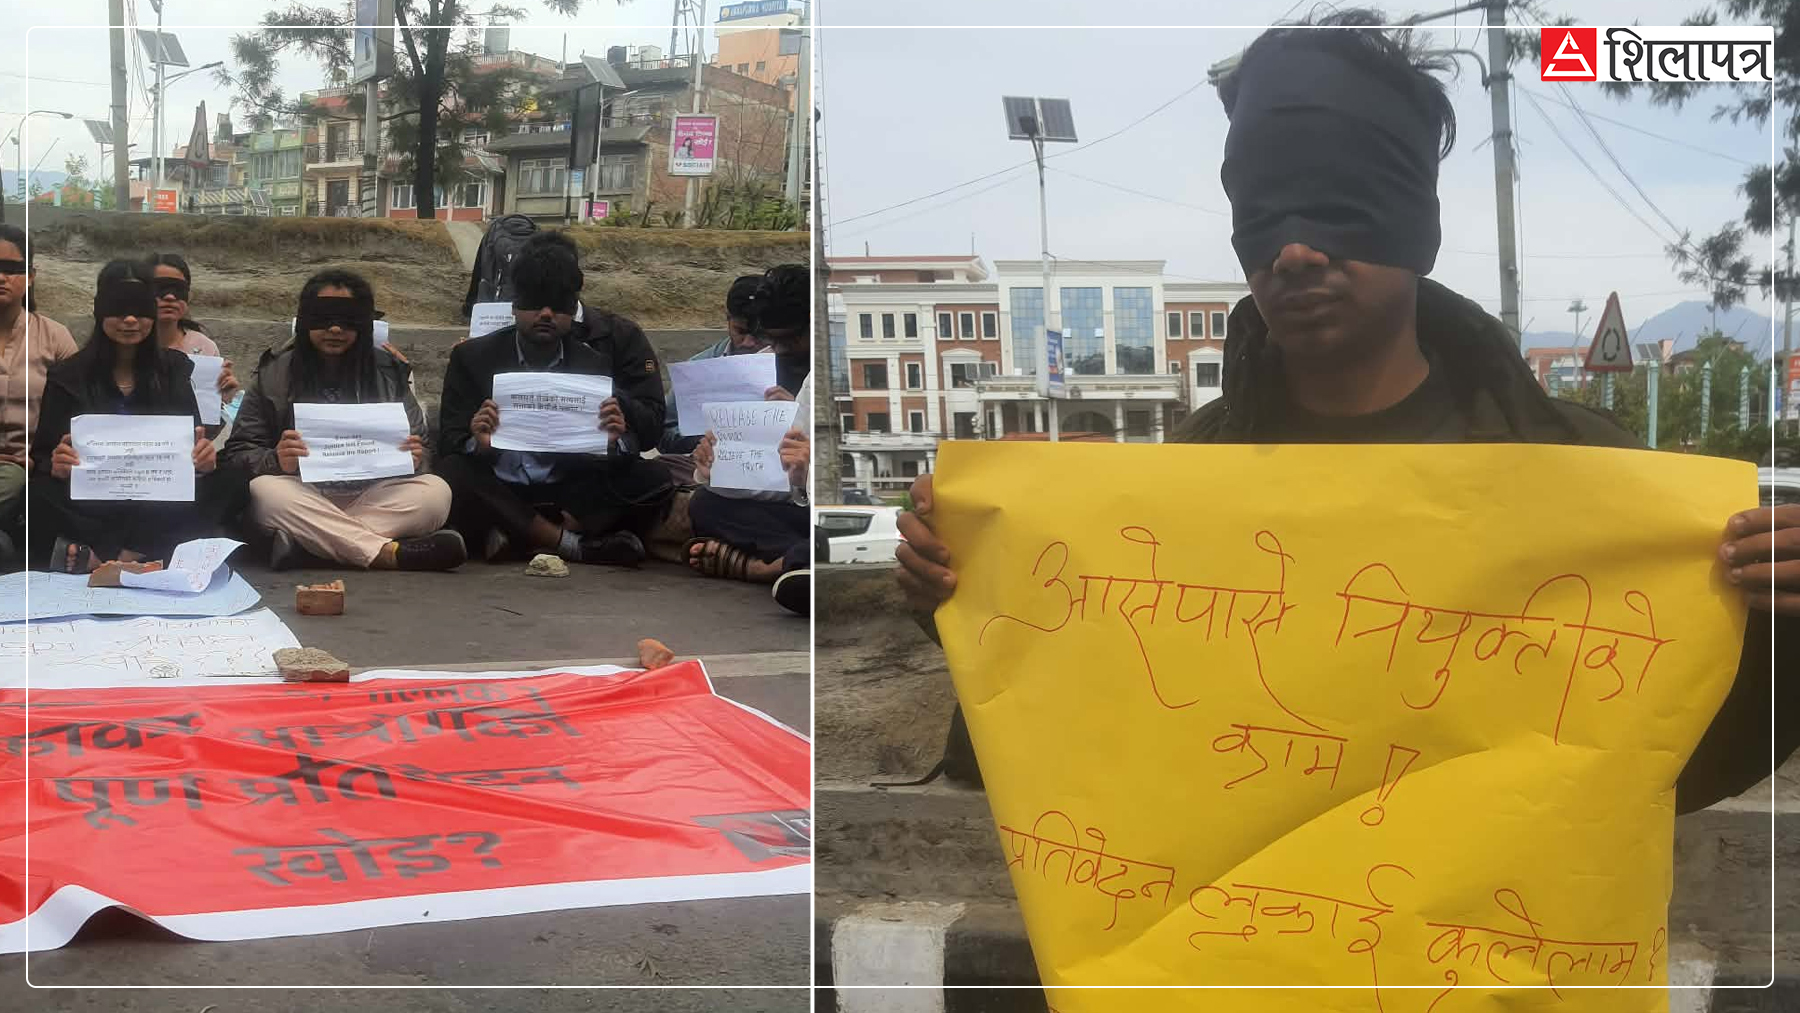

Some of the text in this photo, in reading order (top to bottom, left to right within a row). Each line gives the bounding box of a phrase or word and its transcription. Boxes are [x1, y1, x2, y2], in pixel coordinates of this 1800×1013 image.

[762, 1, 786, 13] HOSPITAL
[708, 408, 787, 427] RELEASE THE
[749, 449, 765, 461] THE
[742, 461, 765, 474] TRUTH
[1212, 723, 1348, 789] काम
[1000, 810, 1175, 931] प्रतिवेदन
